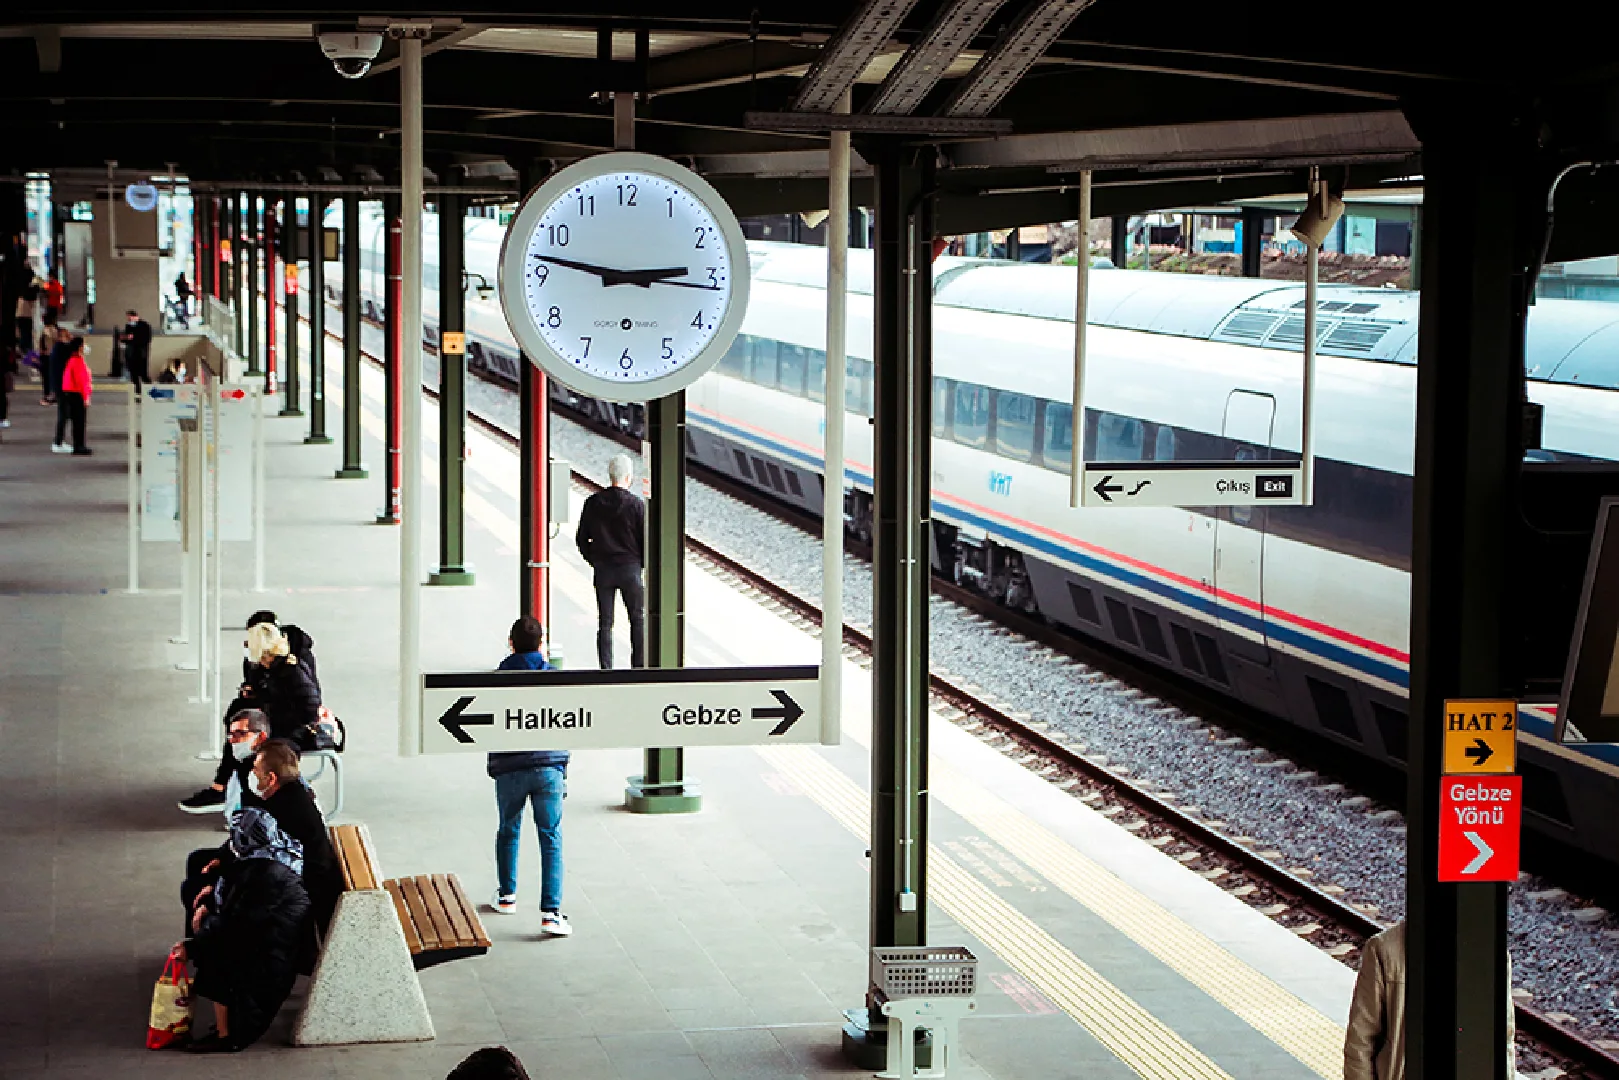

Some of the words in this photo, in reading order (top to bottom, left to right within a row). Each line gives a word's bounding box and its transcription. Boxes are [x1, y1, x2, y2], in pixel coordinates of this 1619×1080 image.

[577, 195, 594, 216] 11
[617, 185, 636, 206] 12
[666, 197, 673, 218] 1
[548, 225, 569, 246] 10
[695, 227, 706, 249] 2
[535, 264, 549, 287] 9
[706, 267, 717, 289] 3
[547, 306, 561, 328] 8
[690, 311, 704, 329] 4
[580, 337, 592, 358] 7
[661, 338, 674, 360] 5
[619, 348, 634, 370] 6
[1215, 478, 1250, 495] Çıkış
[1263, 480, 1286, 492] Exit
[505, 707, 593, 731] Halkalı
[661, 703, 741, 727] Gebze
[1448, 713, 1497, 731] HAT
[1502, 713, 1514, 731] 2
[1450, 783, 1512, 802] Gebze
[1454, 805, 1504, 825] Yönü
